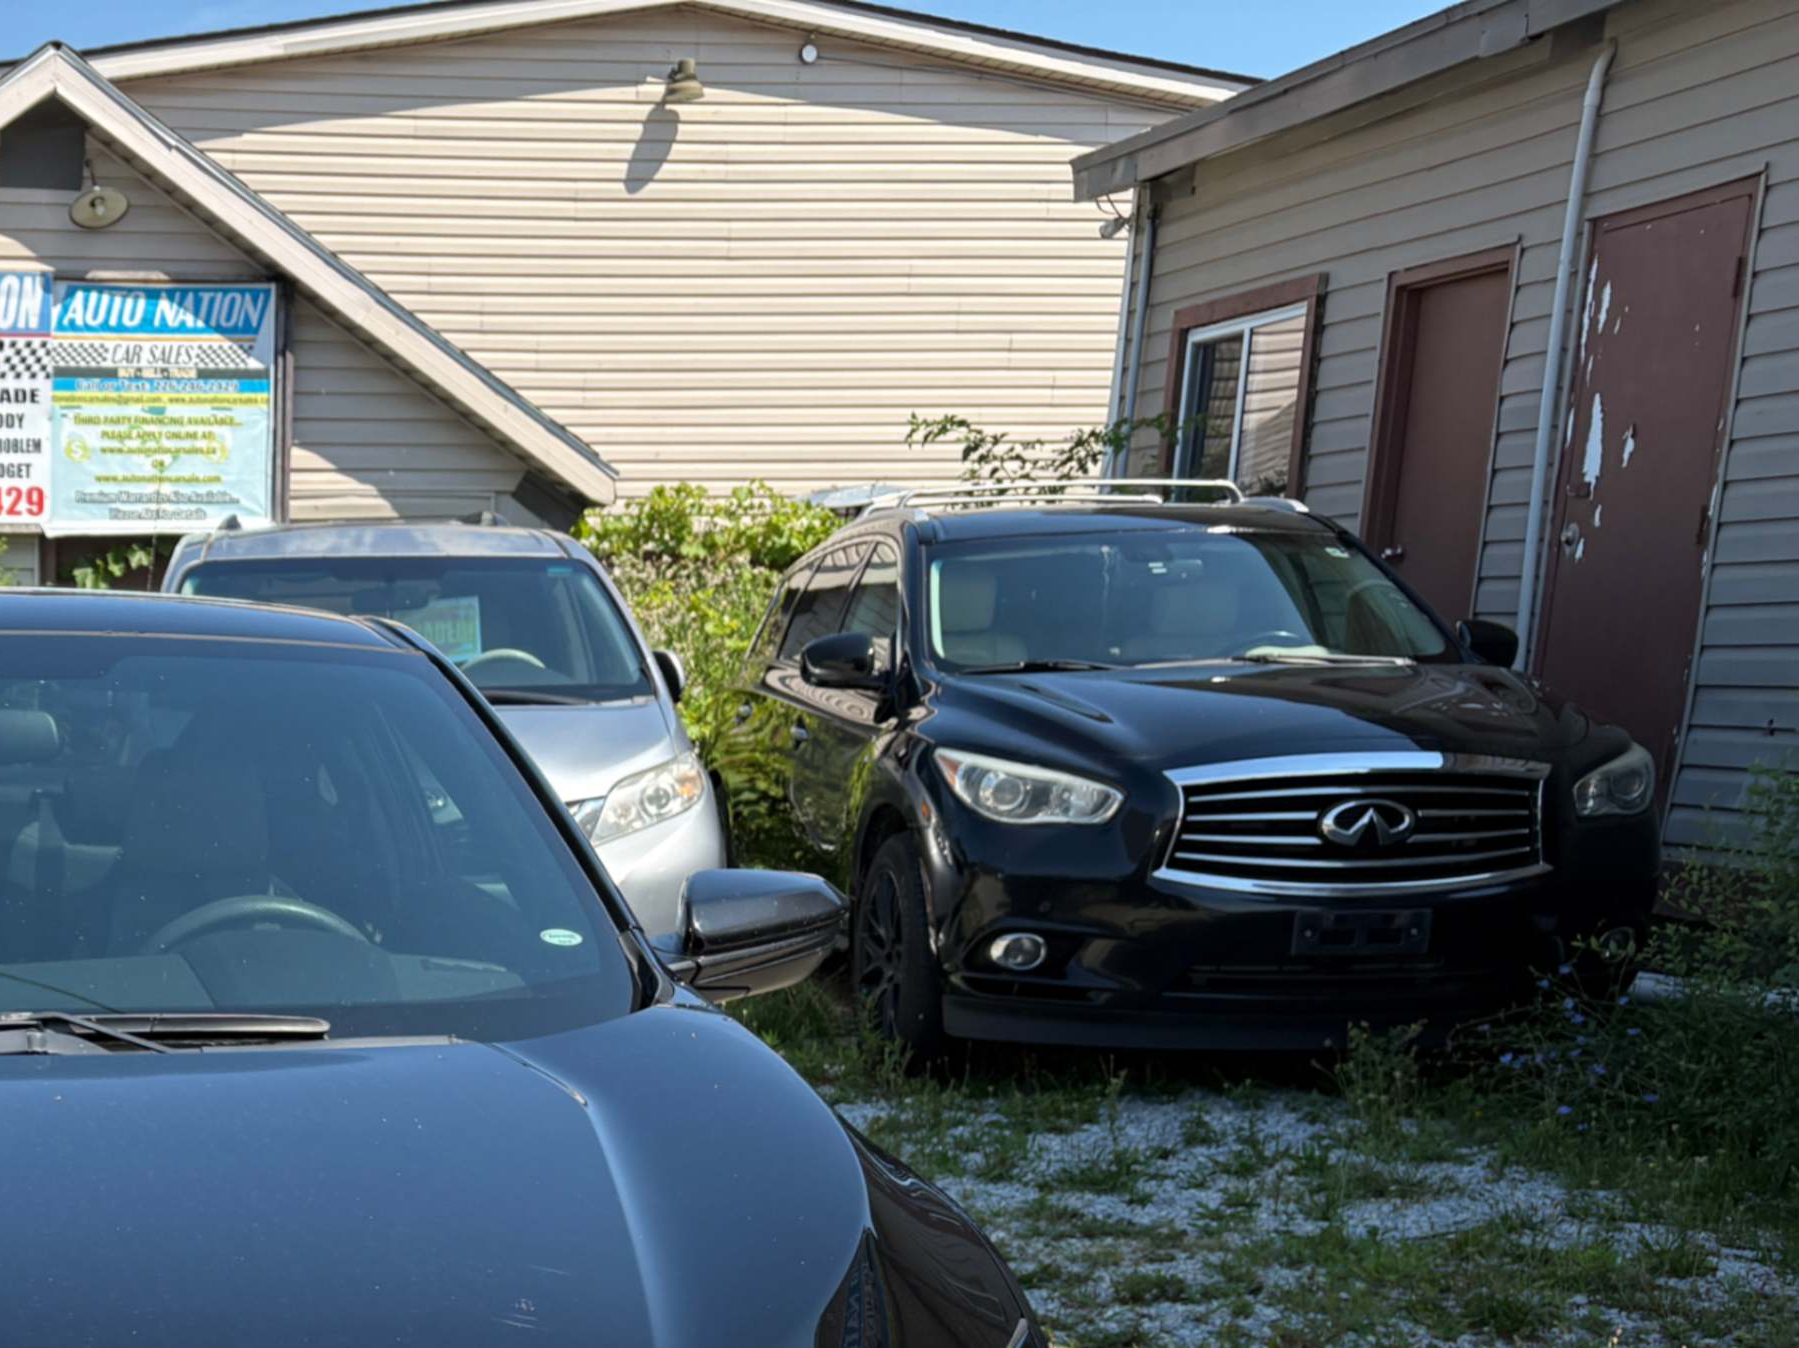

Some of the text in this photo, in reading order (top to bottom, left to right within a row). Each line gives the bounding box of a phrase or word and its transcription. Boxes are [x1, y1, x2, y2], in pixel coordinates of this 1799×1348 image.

[62, 290, 266, 328] AUTO NATION
[111, 343, 195, 366] CAR SALES
